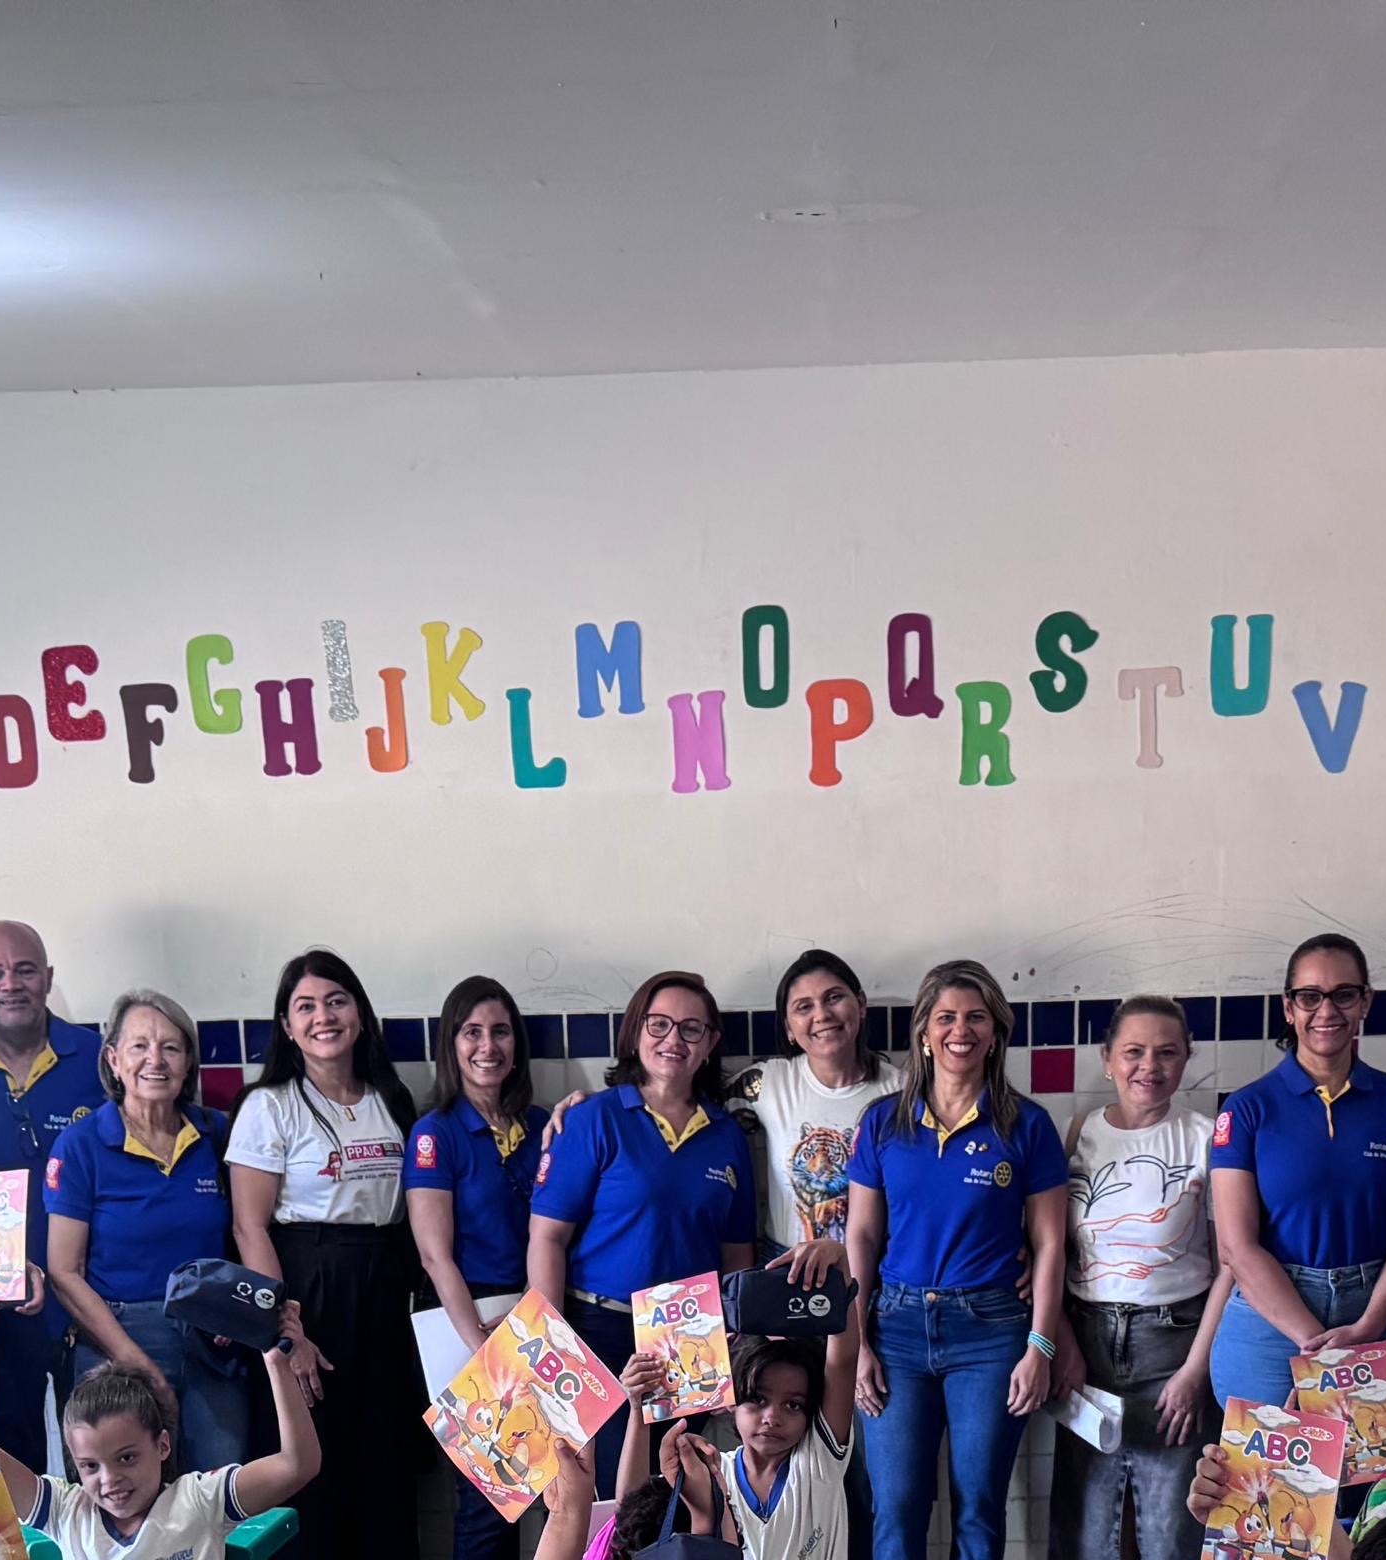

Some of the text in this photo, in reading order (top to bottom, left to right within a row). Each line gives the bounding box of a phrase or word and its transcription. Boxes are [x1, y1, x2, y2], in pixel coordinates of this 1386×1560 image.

[41, 644, 107, 742] E
[119, 682, 178, 784] F
[185, 633, 242, 734] G
[255, 678, 322, 777] H
[321, 619, 360, 723] I
[365, 667, 409, 772] J
[420, 621, 486, 725] K
[506, 687, 567, 789] L
[575, 620, 645, 718] M
[667, 690, 731, 793] N
[742, 604, 790, 708] O
[805, 679, 873, 787] P
[887, 612, 944, 719] Q
[955, 681, 1017, 786] R
[1029, 610, 1099, 713] S
[1117, 666, 1184, 769] T
[1210, 613, 1274, 717] U
[1292, 680, 1368, 774] V
[346, 1145, 383, 1160] PPAIC
[651, 1298, 698, 1327] ABC
[517, 1336, 581, 1401] ABC
[1319, 1363, 1373, 1392] ABC
[1244, 1430, 1311, 1465] ABC
